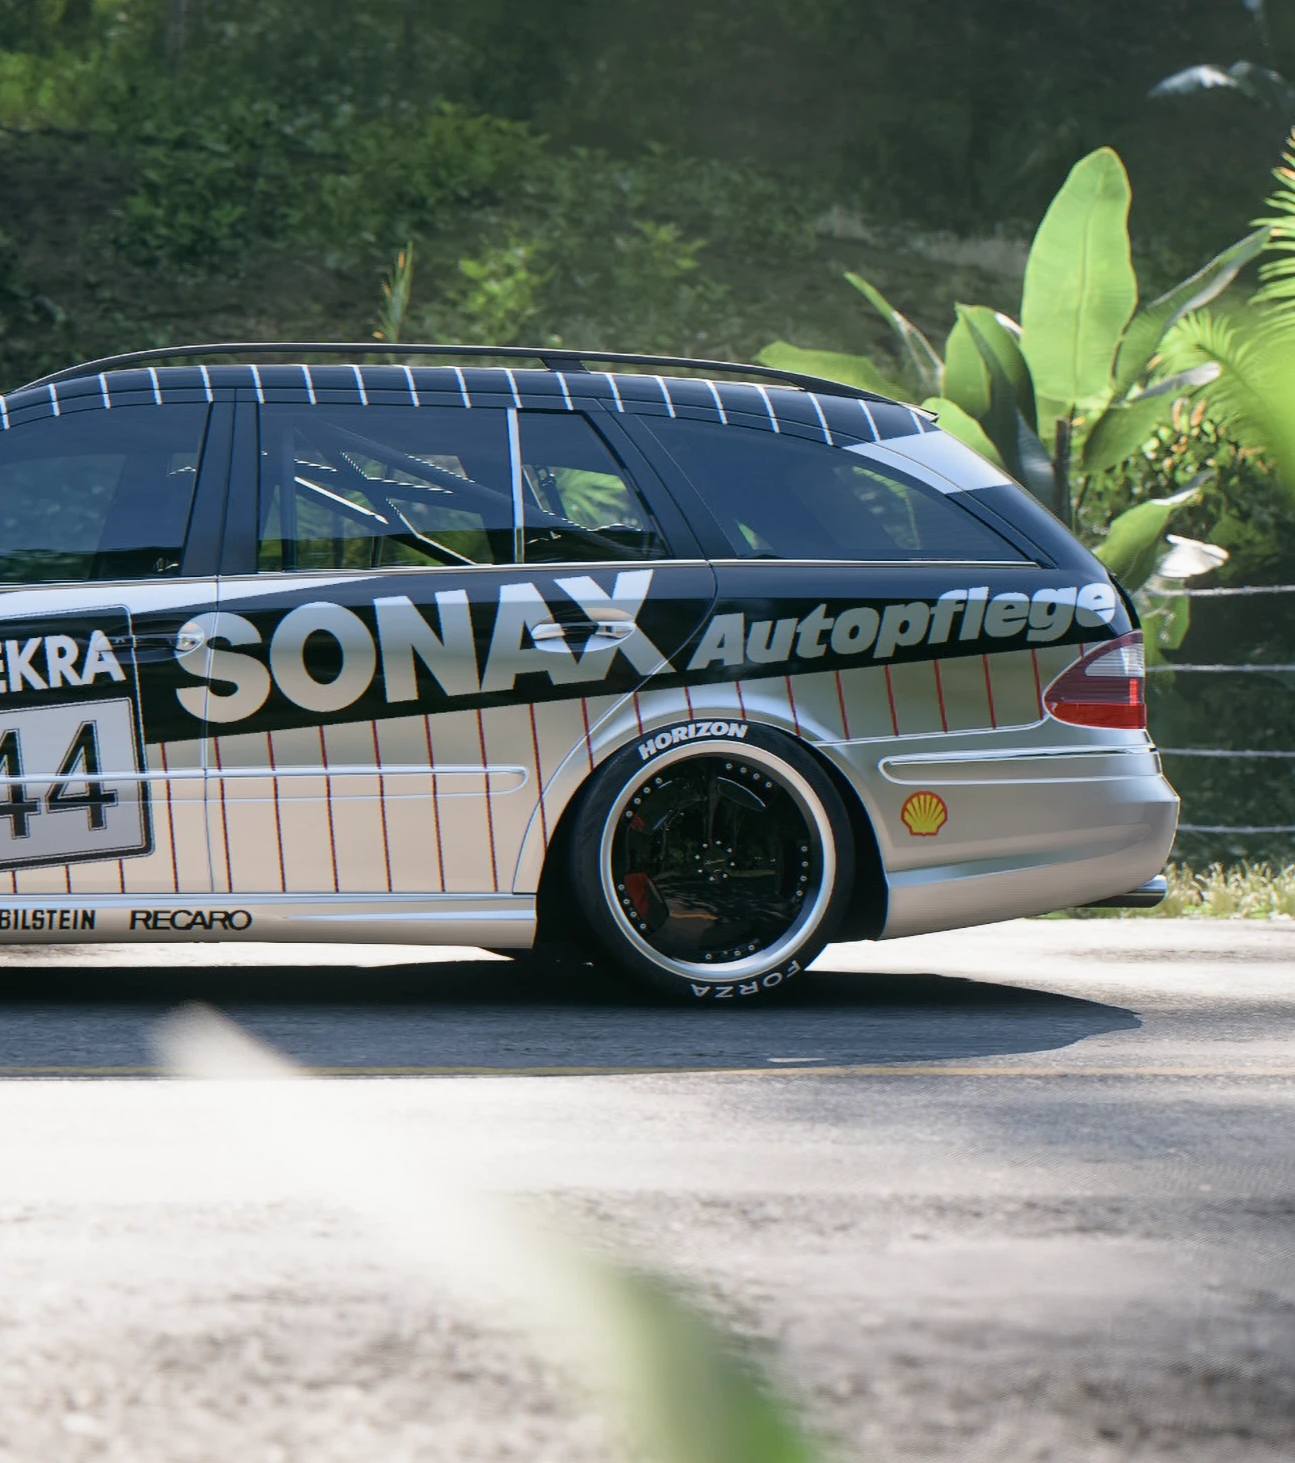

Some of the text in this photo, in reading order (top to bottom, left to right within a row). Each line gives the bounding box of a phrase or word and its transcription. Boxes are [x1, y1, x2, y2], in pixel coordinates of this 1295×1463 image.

[174, 569, 1117, 724] SONAX Autopflege
[637, 721, 749, 761] HORIZON
[129, 909, 253, 931] RECARO
[690, 960, 802, 998] FORZA
